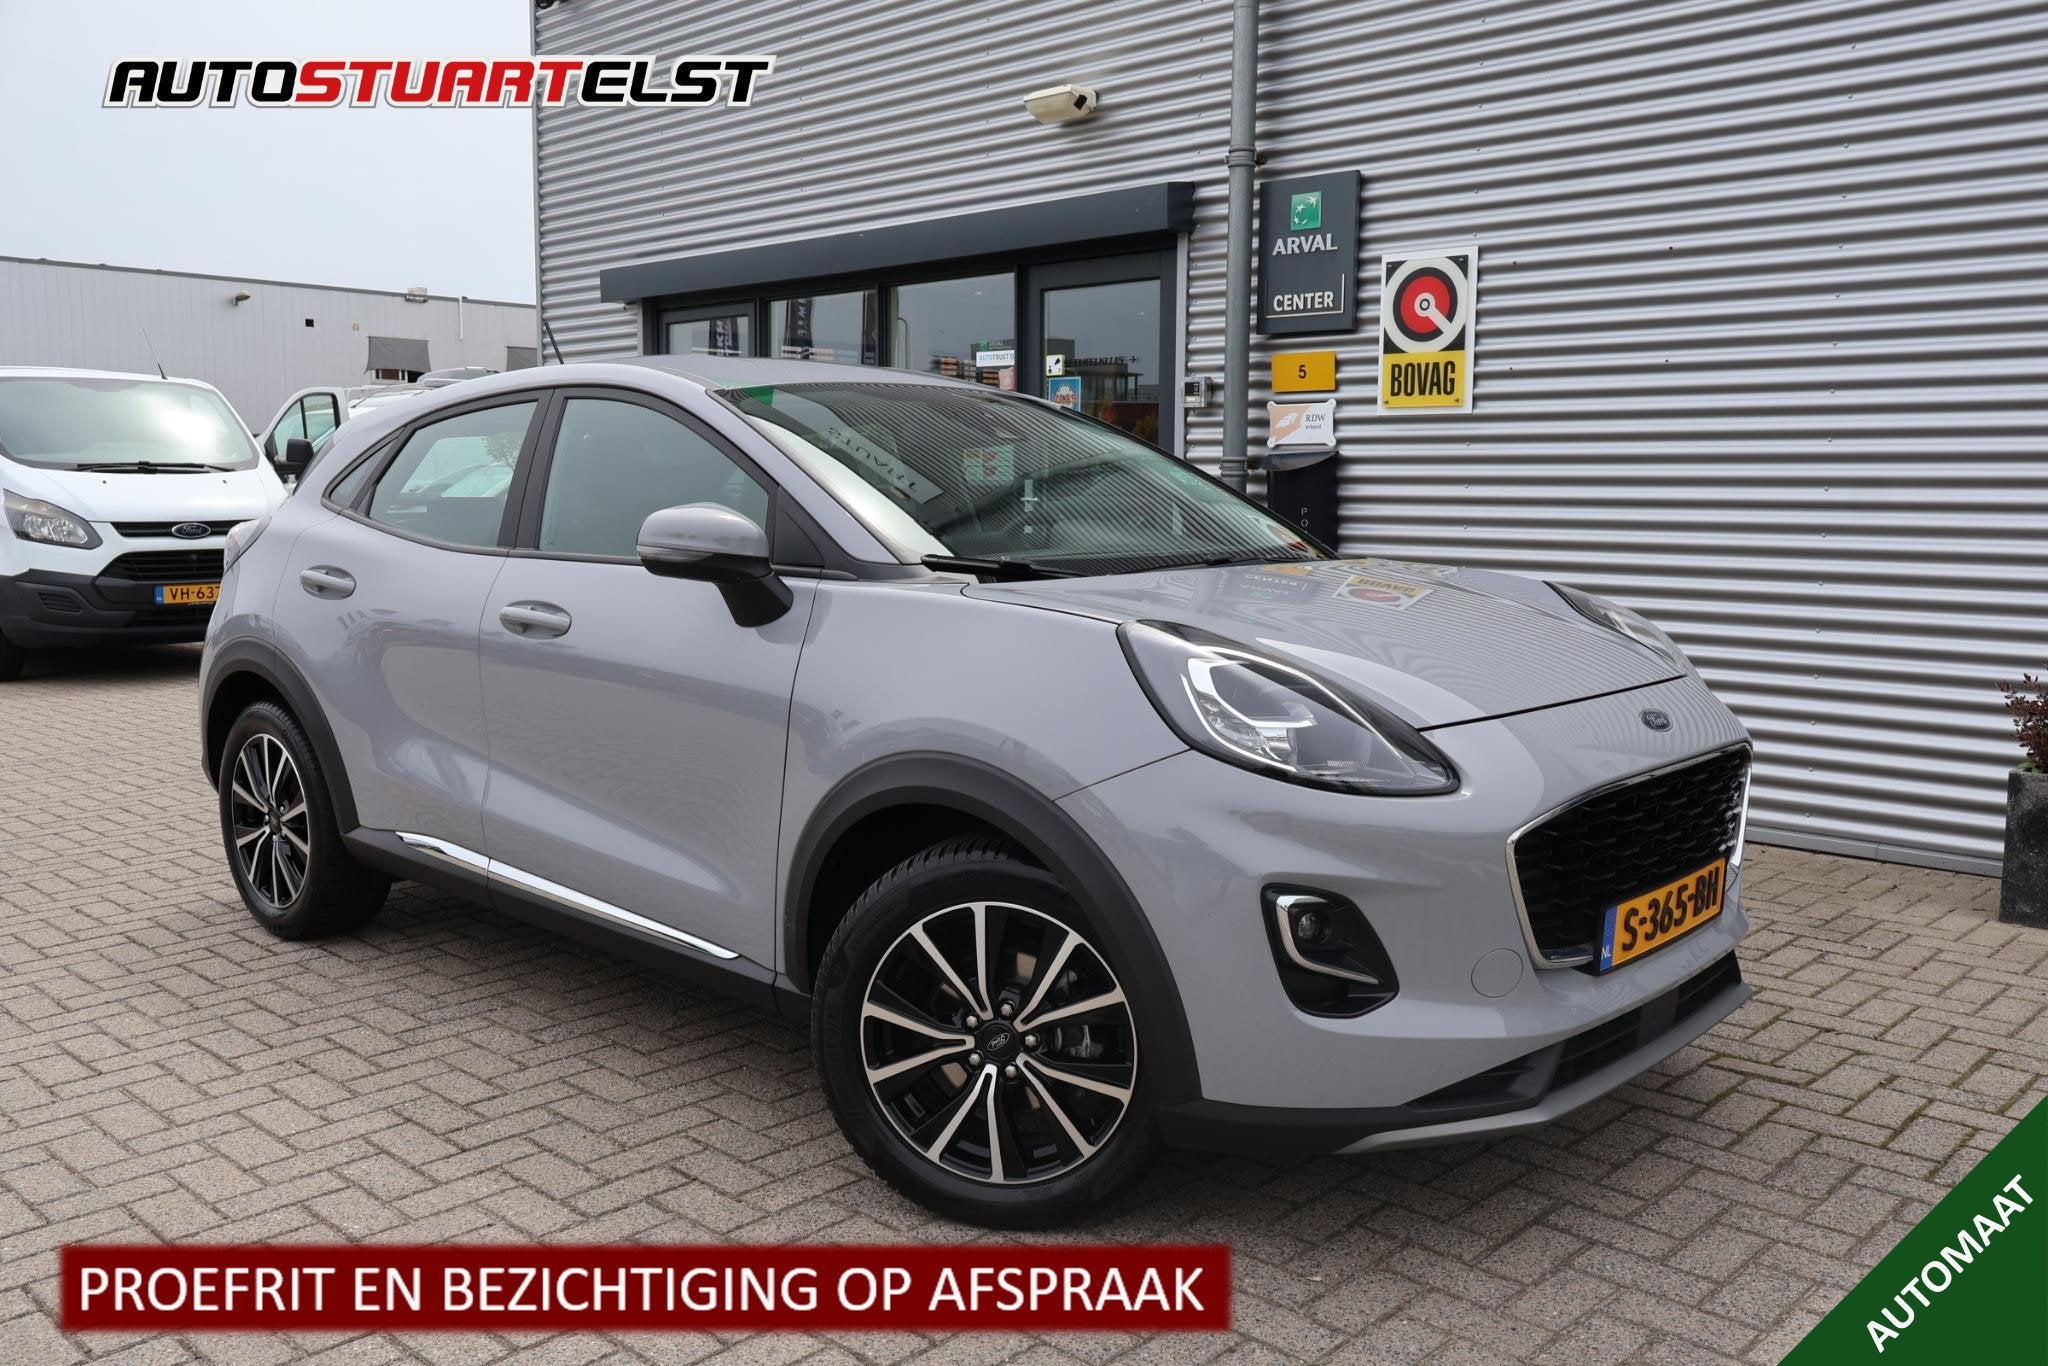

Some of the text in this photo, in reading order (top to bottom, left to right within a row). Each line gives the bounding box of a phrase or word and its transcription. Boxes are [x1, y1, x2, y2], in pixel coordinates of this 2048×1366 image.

[1272, 233, 1338, 255] ARVAL
[1273, 291, 1334, 312] CENTER
[1298, 364, 1307, 379] 5
[1390, 360, 1456, 397] BOVAG
[1305, 413, 1326, 423] RDW
[1621, 866, 1719, 951] S-365-BH
